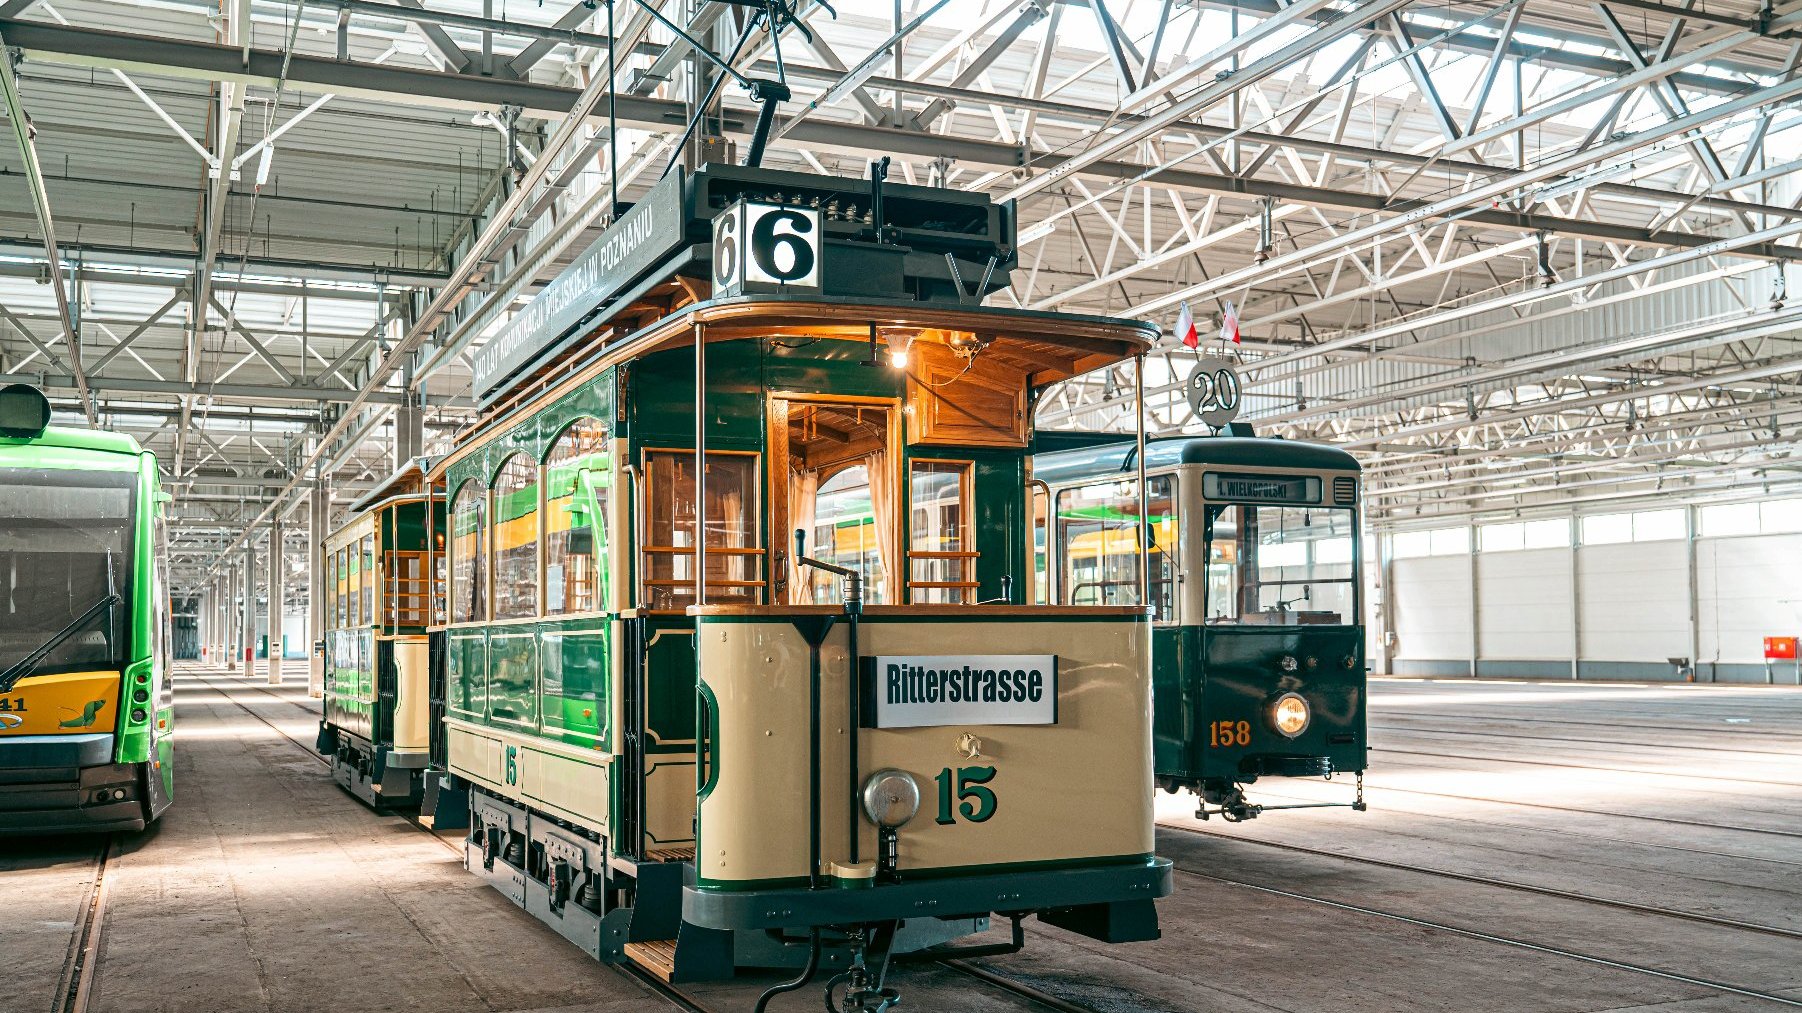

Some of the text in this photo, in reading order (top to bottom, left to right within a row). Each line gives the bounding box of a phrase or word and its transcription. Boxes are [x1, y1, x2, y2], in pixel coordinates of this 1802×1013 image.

[714, 212, 736, 286] 6
[751, 209, 815, 281] 6
[486, 342, 499, 377] LAT
[500, 301, 544, 361] KOMUNIKACJI
[588, 252, 598, 285] W
[600, 203, 653, 277] POZNANIU
[1193, 368, 1238, 416] 20
[1227, 481, 1287, 498] WIELKOPOLSKI
[886, 663, 1043, 705] Ritterstrasse
[1209, 720, 1251, 748] 158
[505, 744, 517, 786] 15
[934, 765, 998, 825] 15
